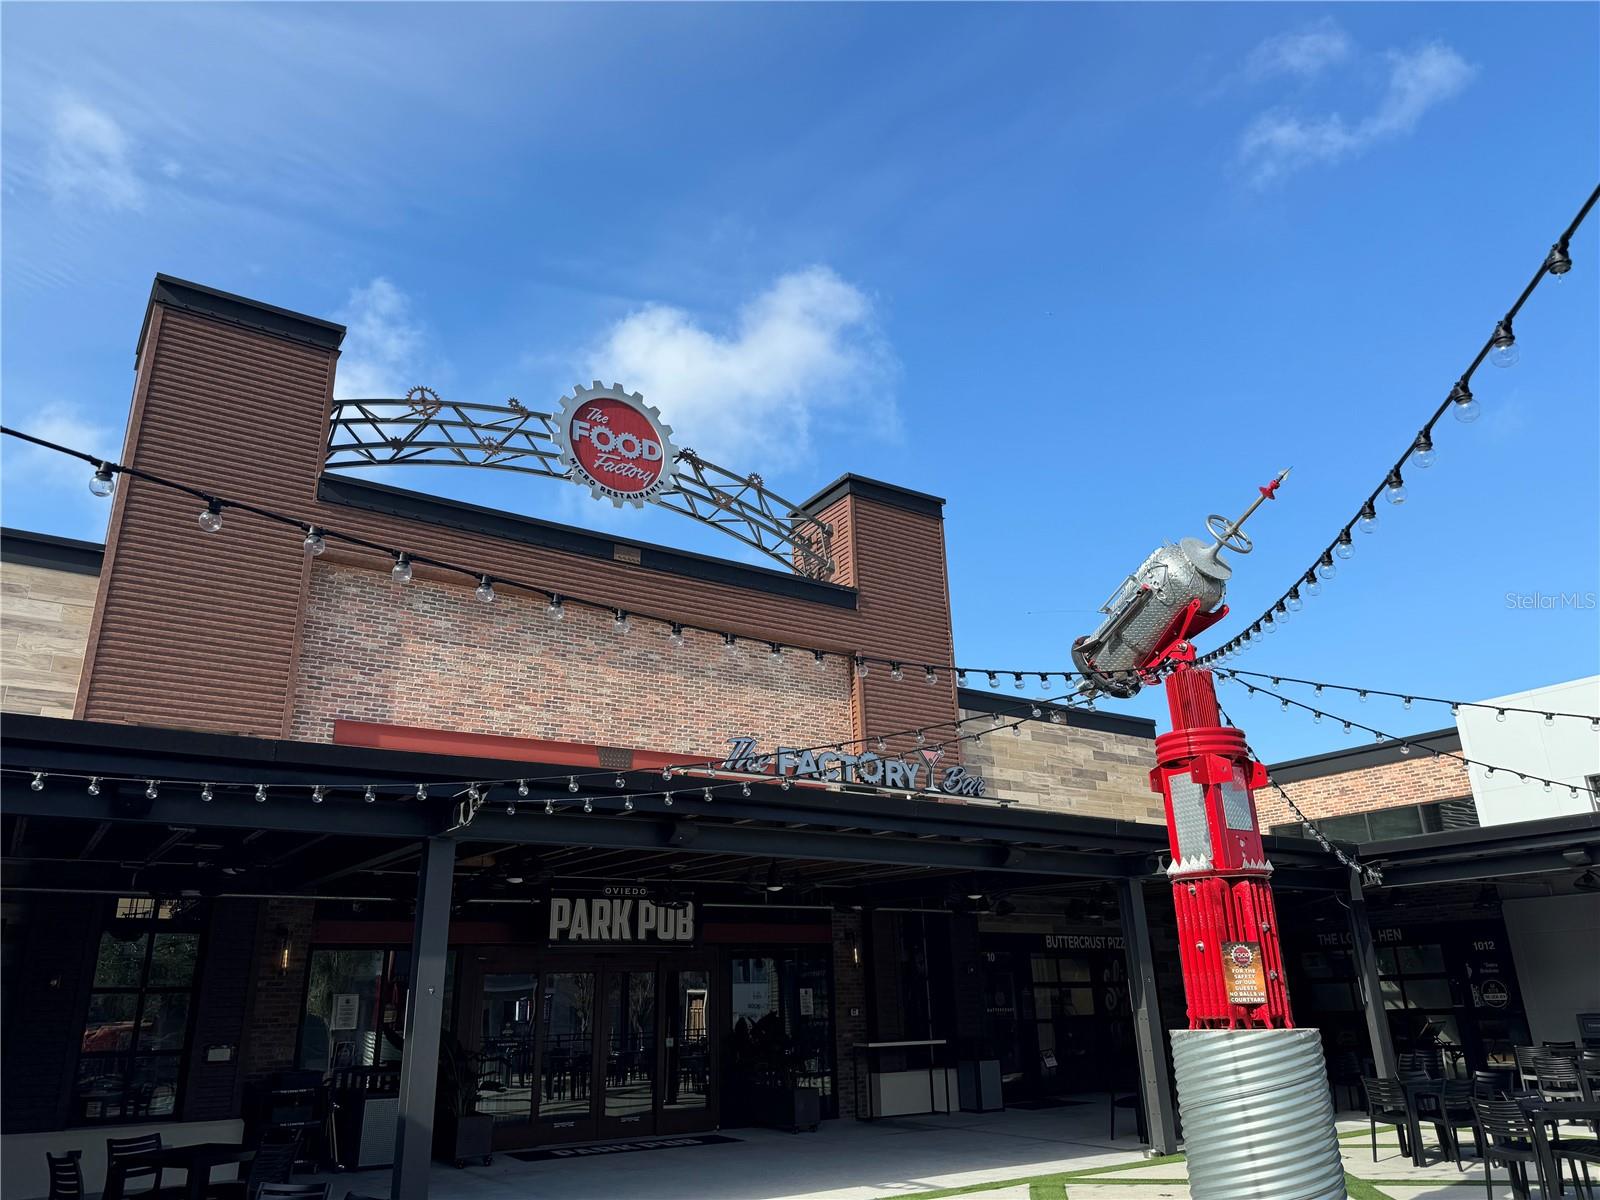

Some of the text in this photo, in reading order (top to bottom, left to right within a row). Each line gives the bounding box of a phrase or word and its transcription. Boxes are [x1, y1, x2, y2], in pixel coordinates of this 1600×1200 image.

[588, 407, 609, 424] The
[572, 419, 662, 461] FOOD
[569, 457, 665, 500] MICRO RESTAURANTS
[593, 453, 655, 487] Factory
[722, 737, 985, 797] The FACTORY Bar
[604, 887, 647, 895] OVIEDO
[549, 898, 694, 941] PARK PUB
[1046, 935, 1126, 949] BUTTERCRUST PIZZ
[1317, 932, 1338, 945] THE
[1378, 928, 1402, 942] HEN
[1473, 940, 1496, 951] 1012
